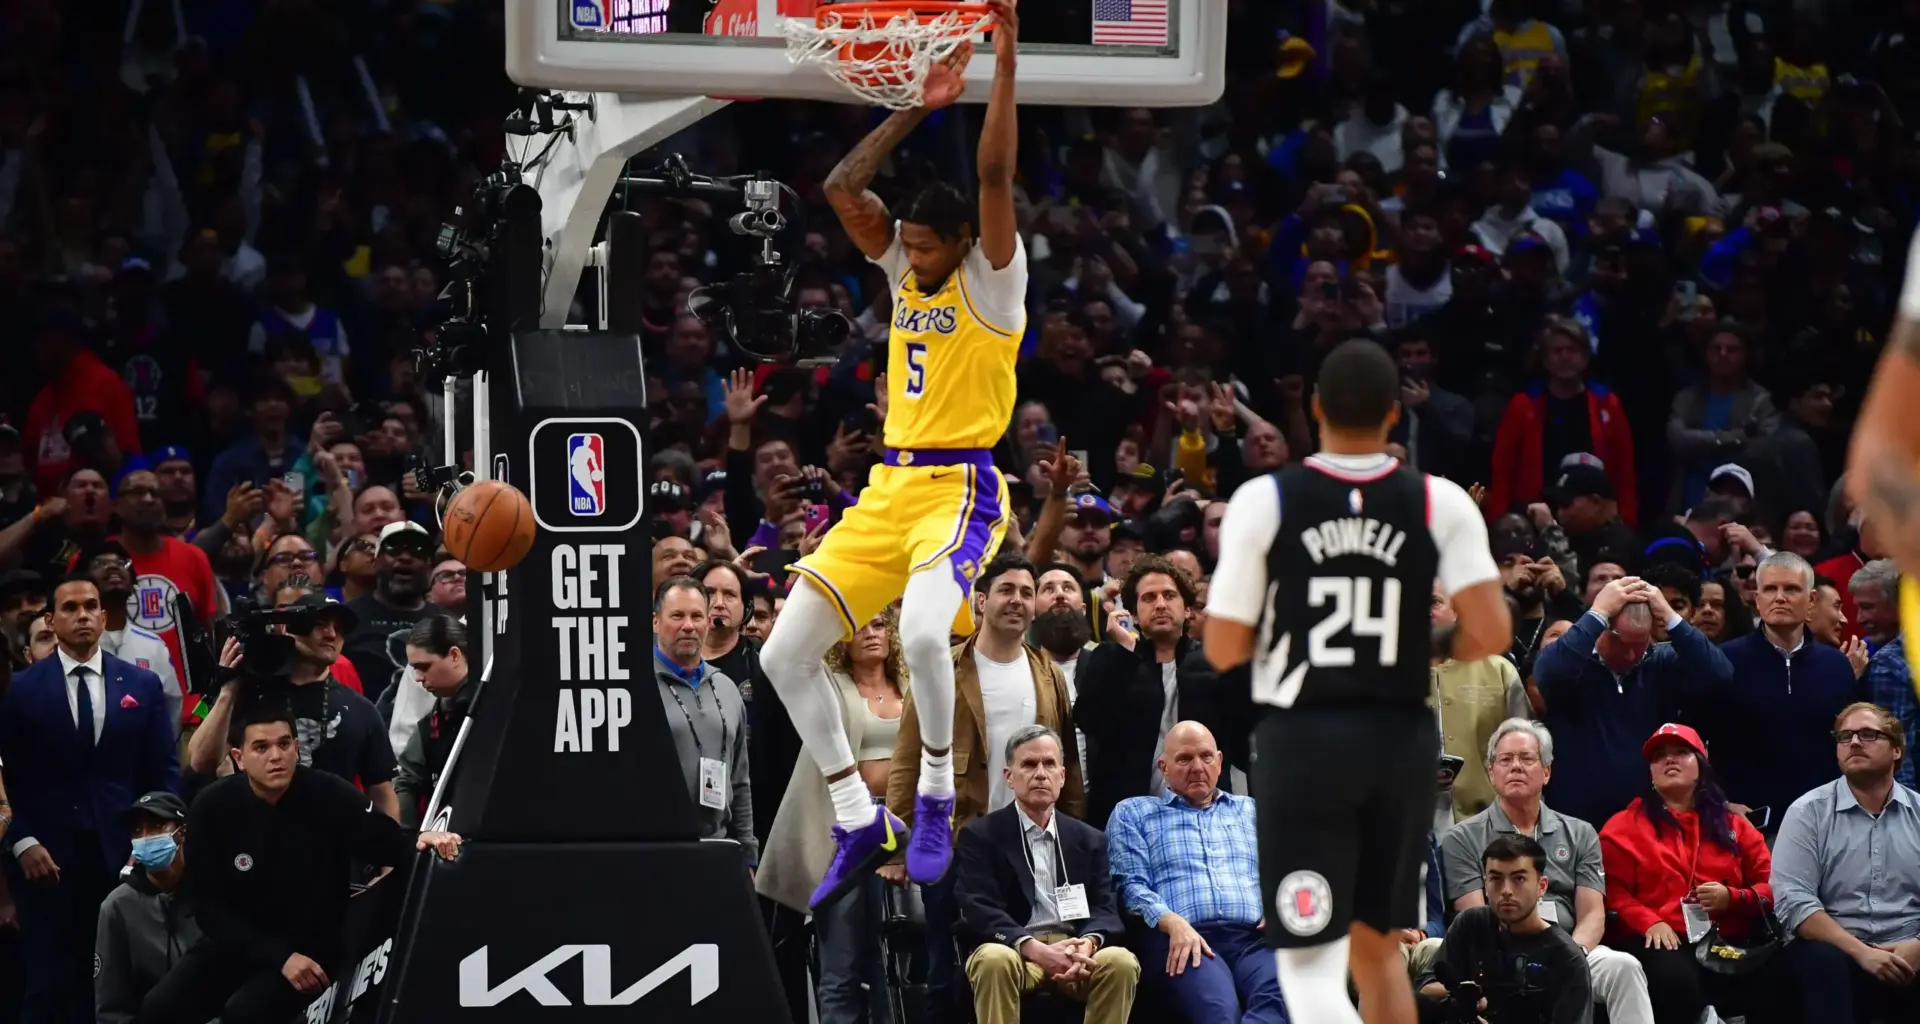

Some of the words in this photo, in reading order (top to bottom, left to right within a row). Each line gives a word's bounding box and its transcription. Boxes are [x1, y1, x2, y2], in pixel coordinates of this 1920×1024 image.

[576, 6, 597, 22] NBA
[905, 342, 928, 395] 5
[574, 496, 592, 511] NBA
[1301, 517, 1407, 568] POWELL
[551, 544, 626, 610] GET
[552, 616, 630, 681] THE
[1307, 576, 1402, 668] 24
[554, 688, 632, 753] APP
[459, 943, 720, 1008] KIA
